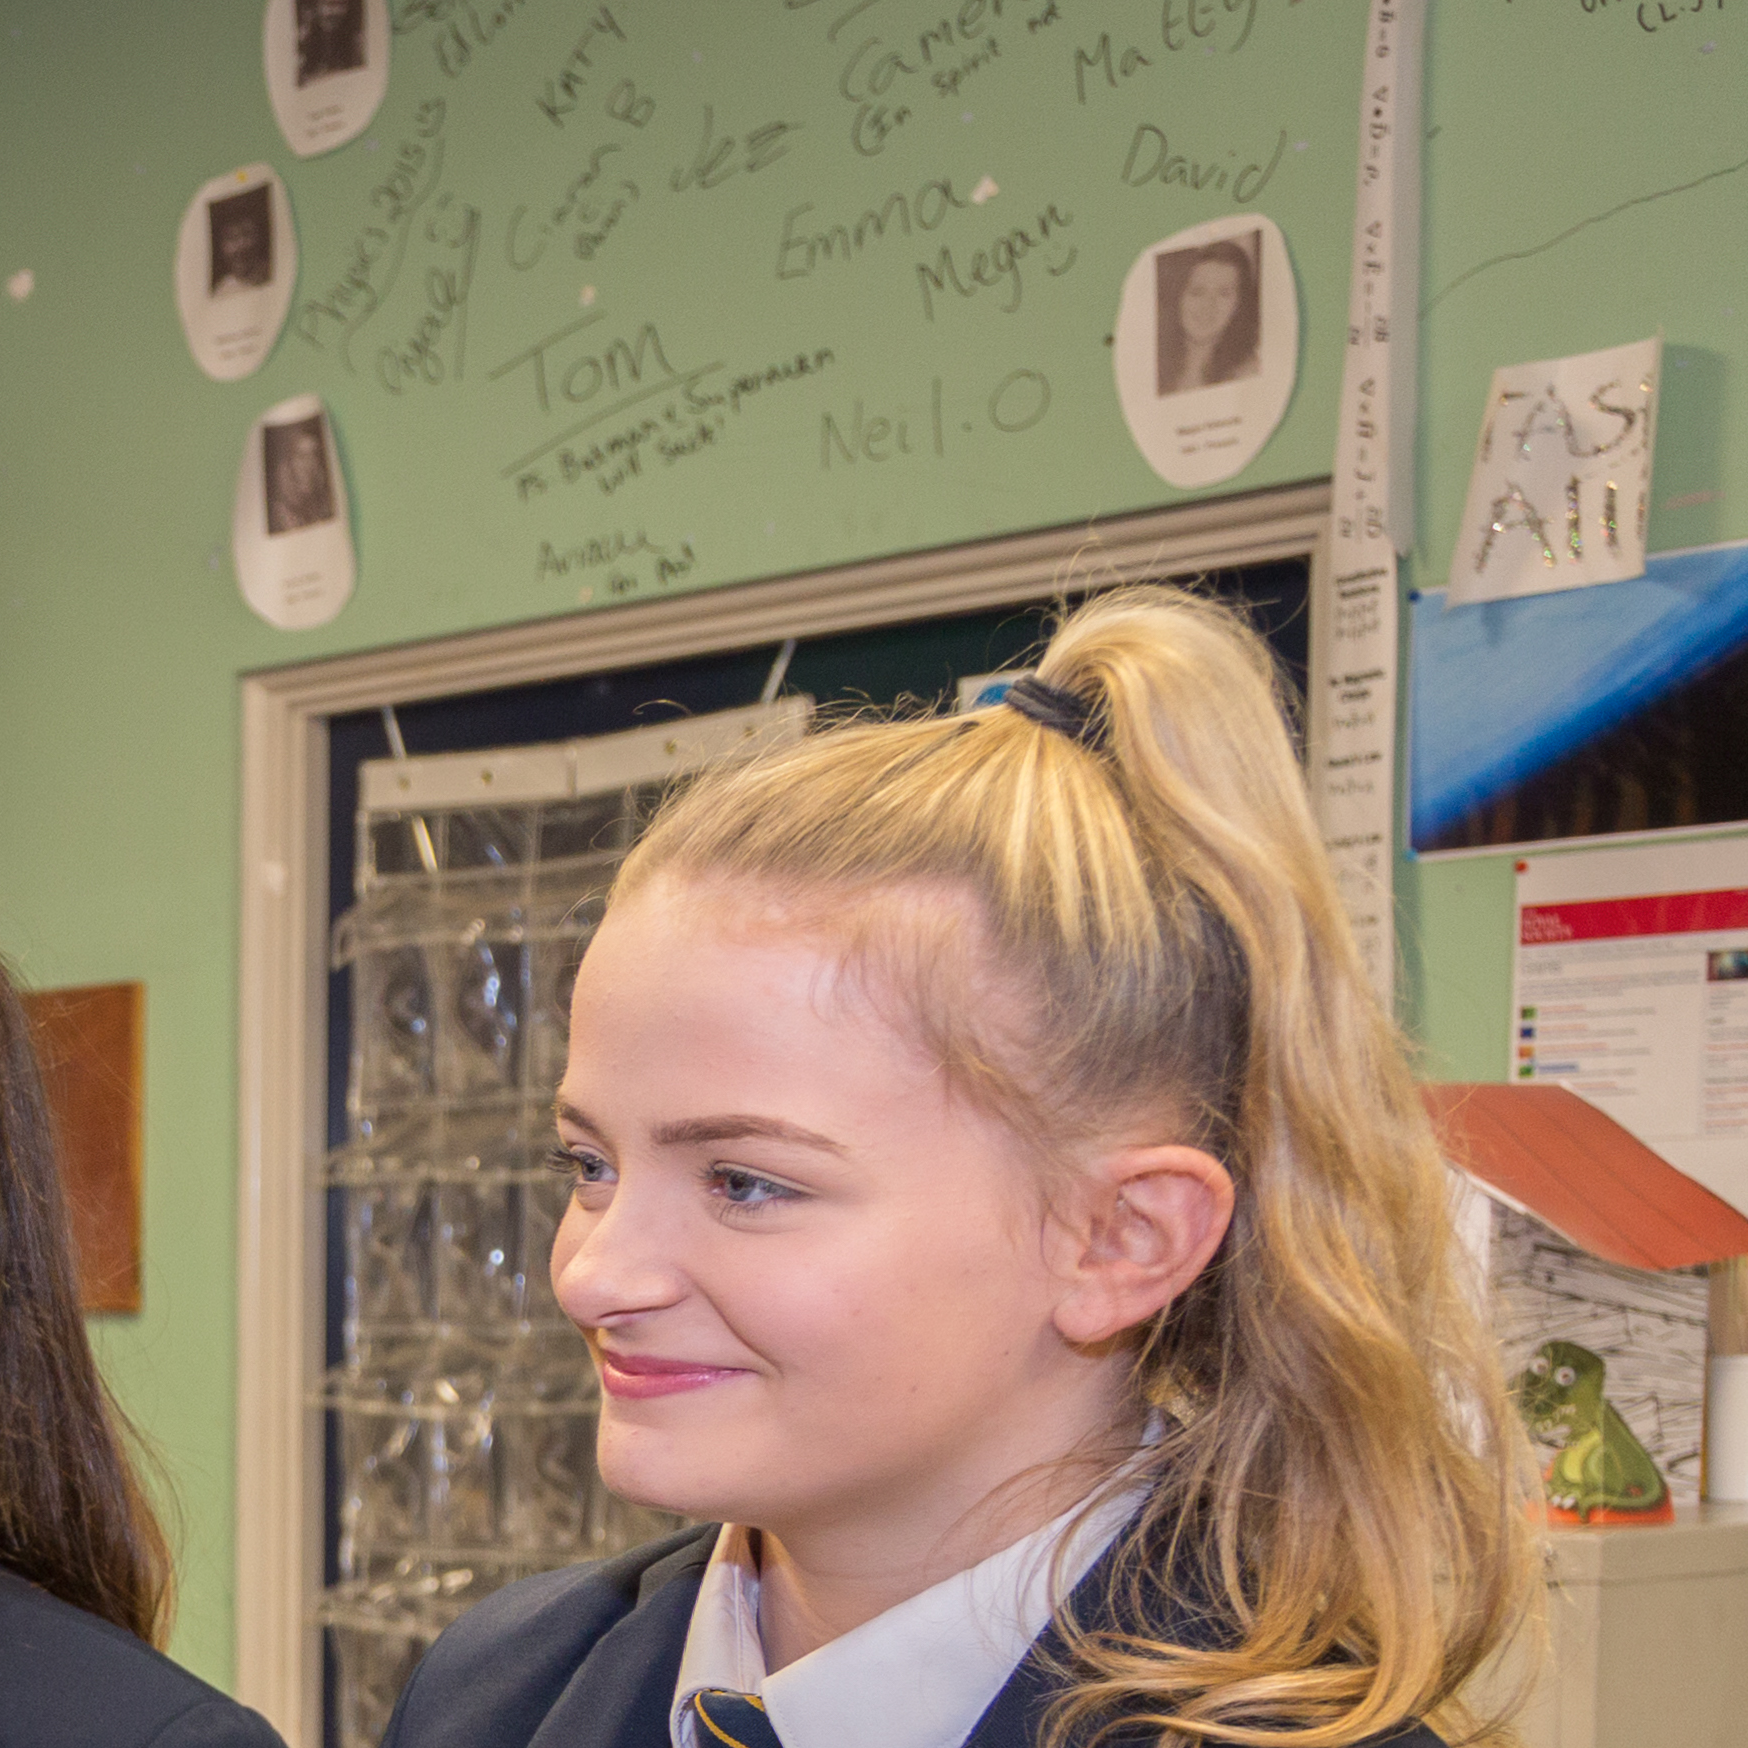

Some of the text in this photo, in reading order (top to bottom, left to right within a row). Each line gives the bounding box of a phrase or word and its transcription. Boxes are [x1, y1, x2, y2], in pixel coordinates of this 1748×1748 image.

[1121, 123, 1288, 203] David
[775, 177, 967, 282] Emma
[916, 204, 1074, 322] Megan
